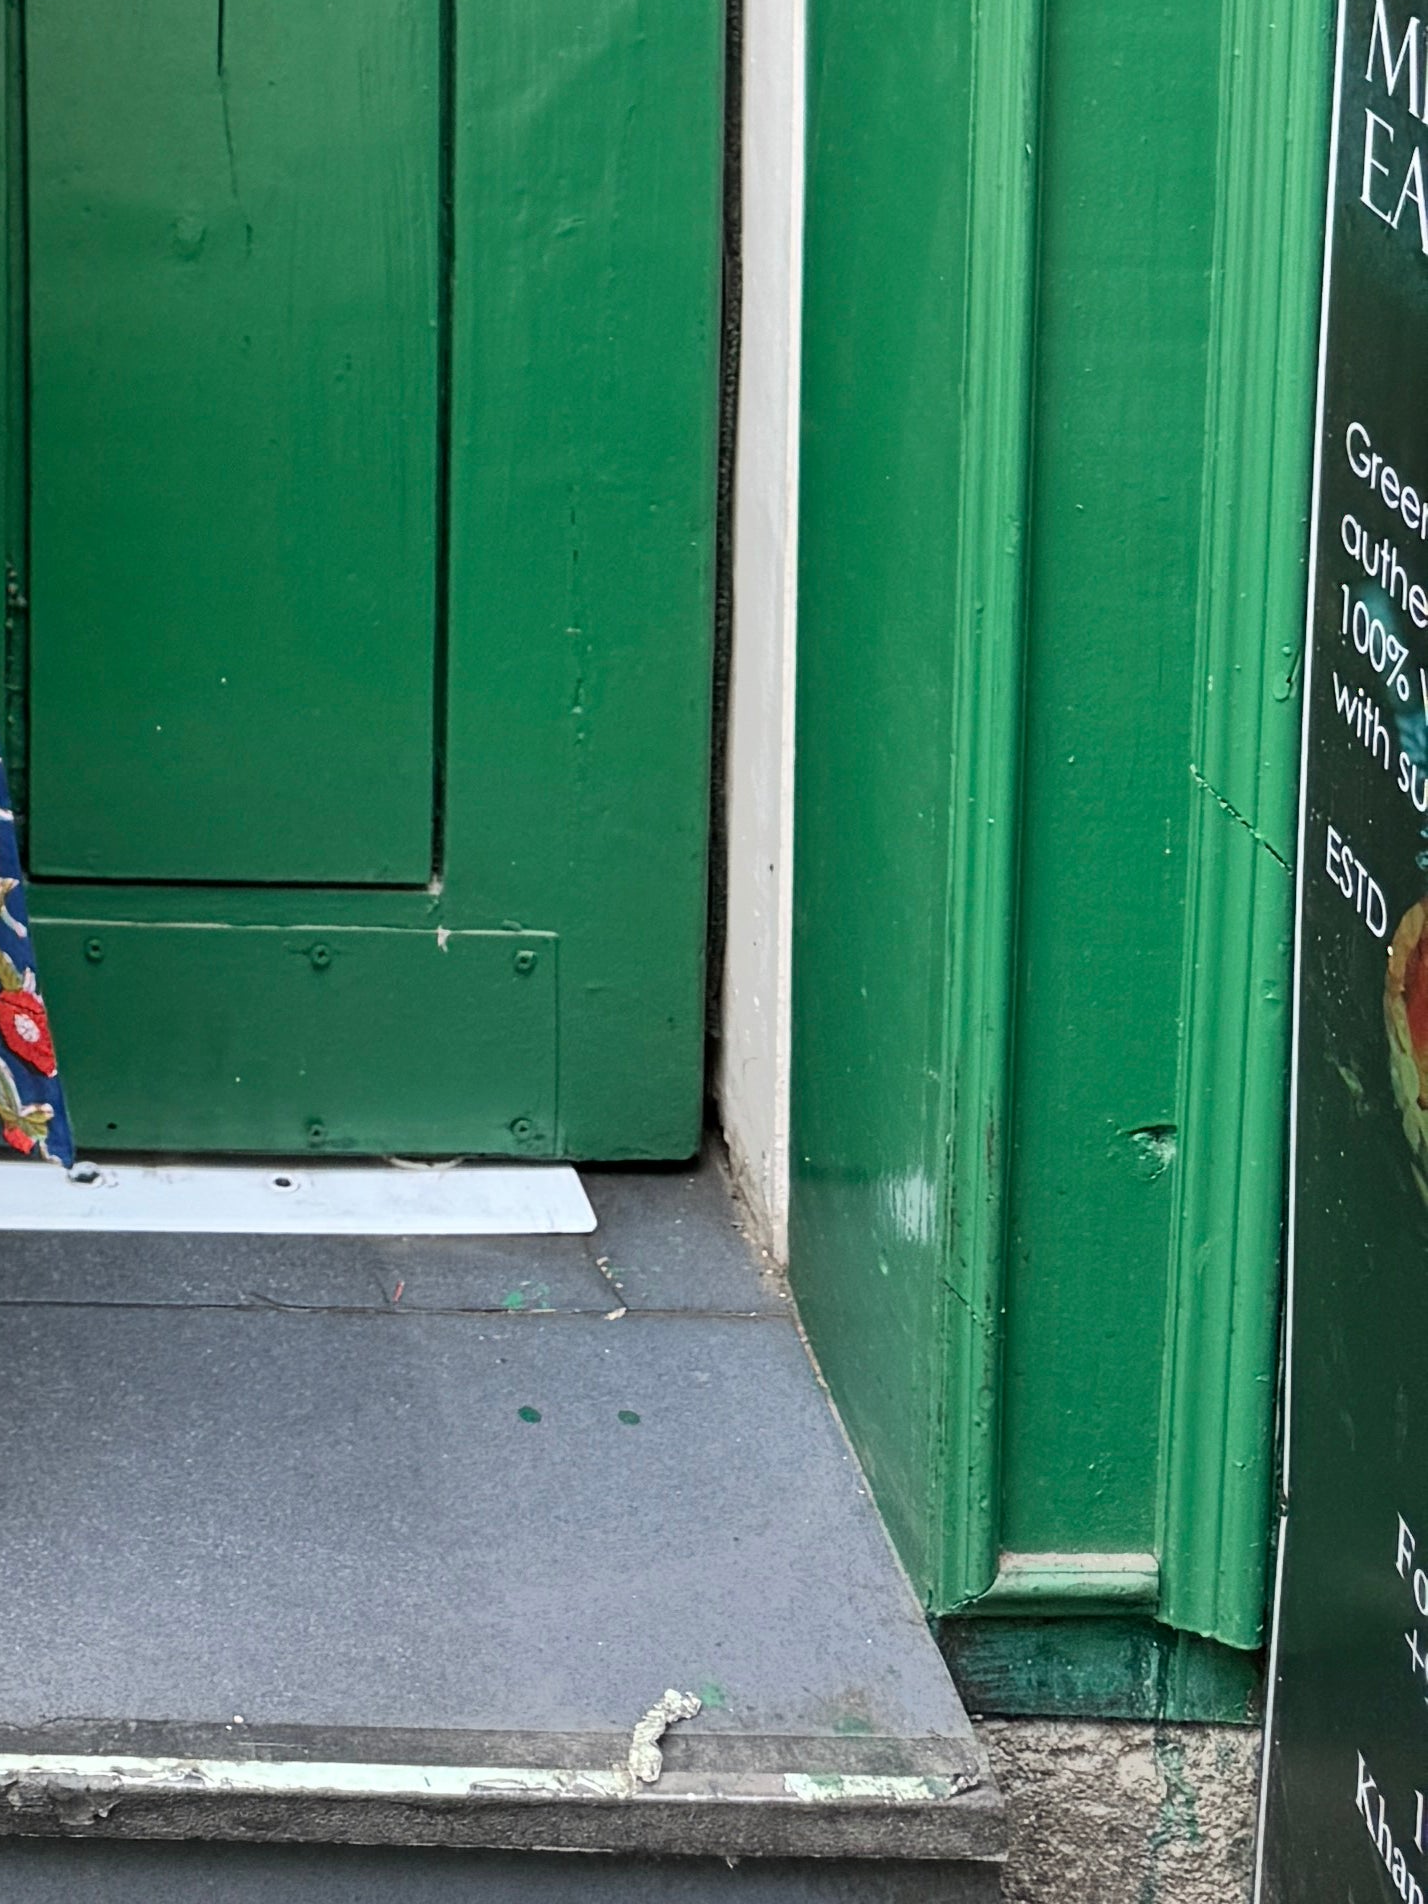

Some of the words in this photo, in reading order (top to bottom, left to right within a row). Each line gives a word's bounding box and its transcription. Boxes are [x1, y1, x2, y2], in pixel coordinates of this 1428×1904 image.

[1341, 583, 1409, 702] 100%
[1332, 671, 1389, 770] with
[1325, 824, 1388, 939] ESTD
